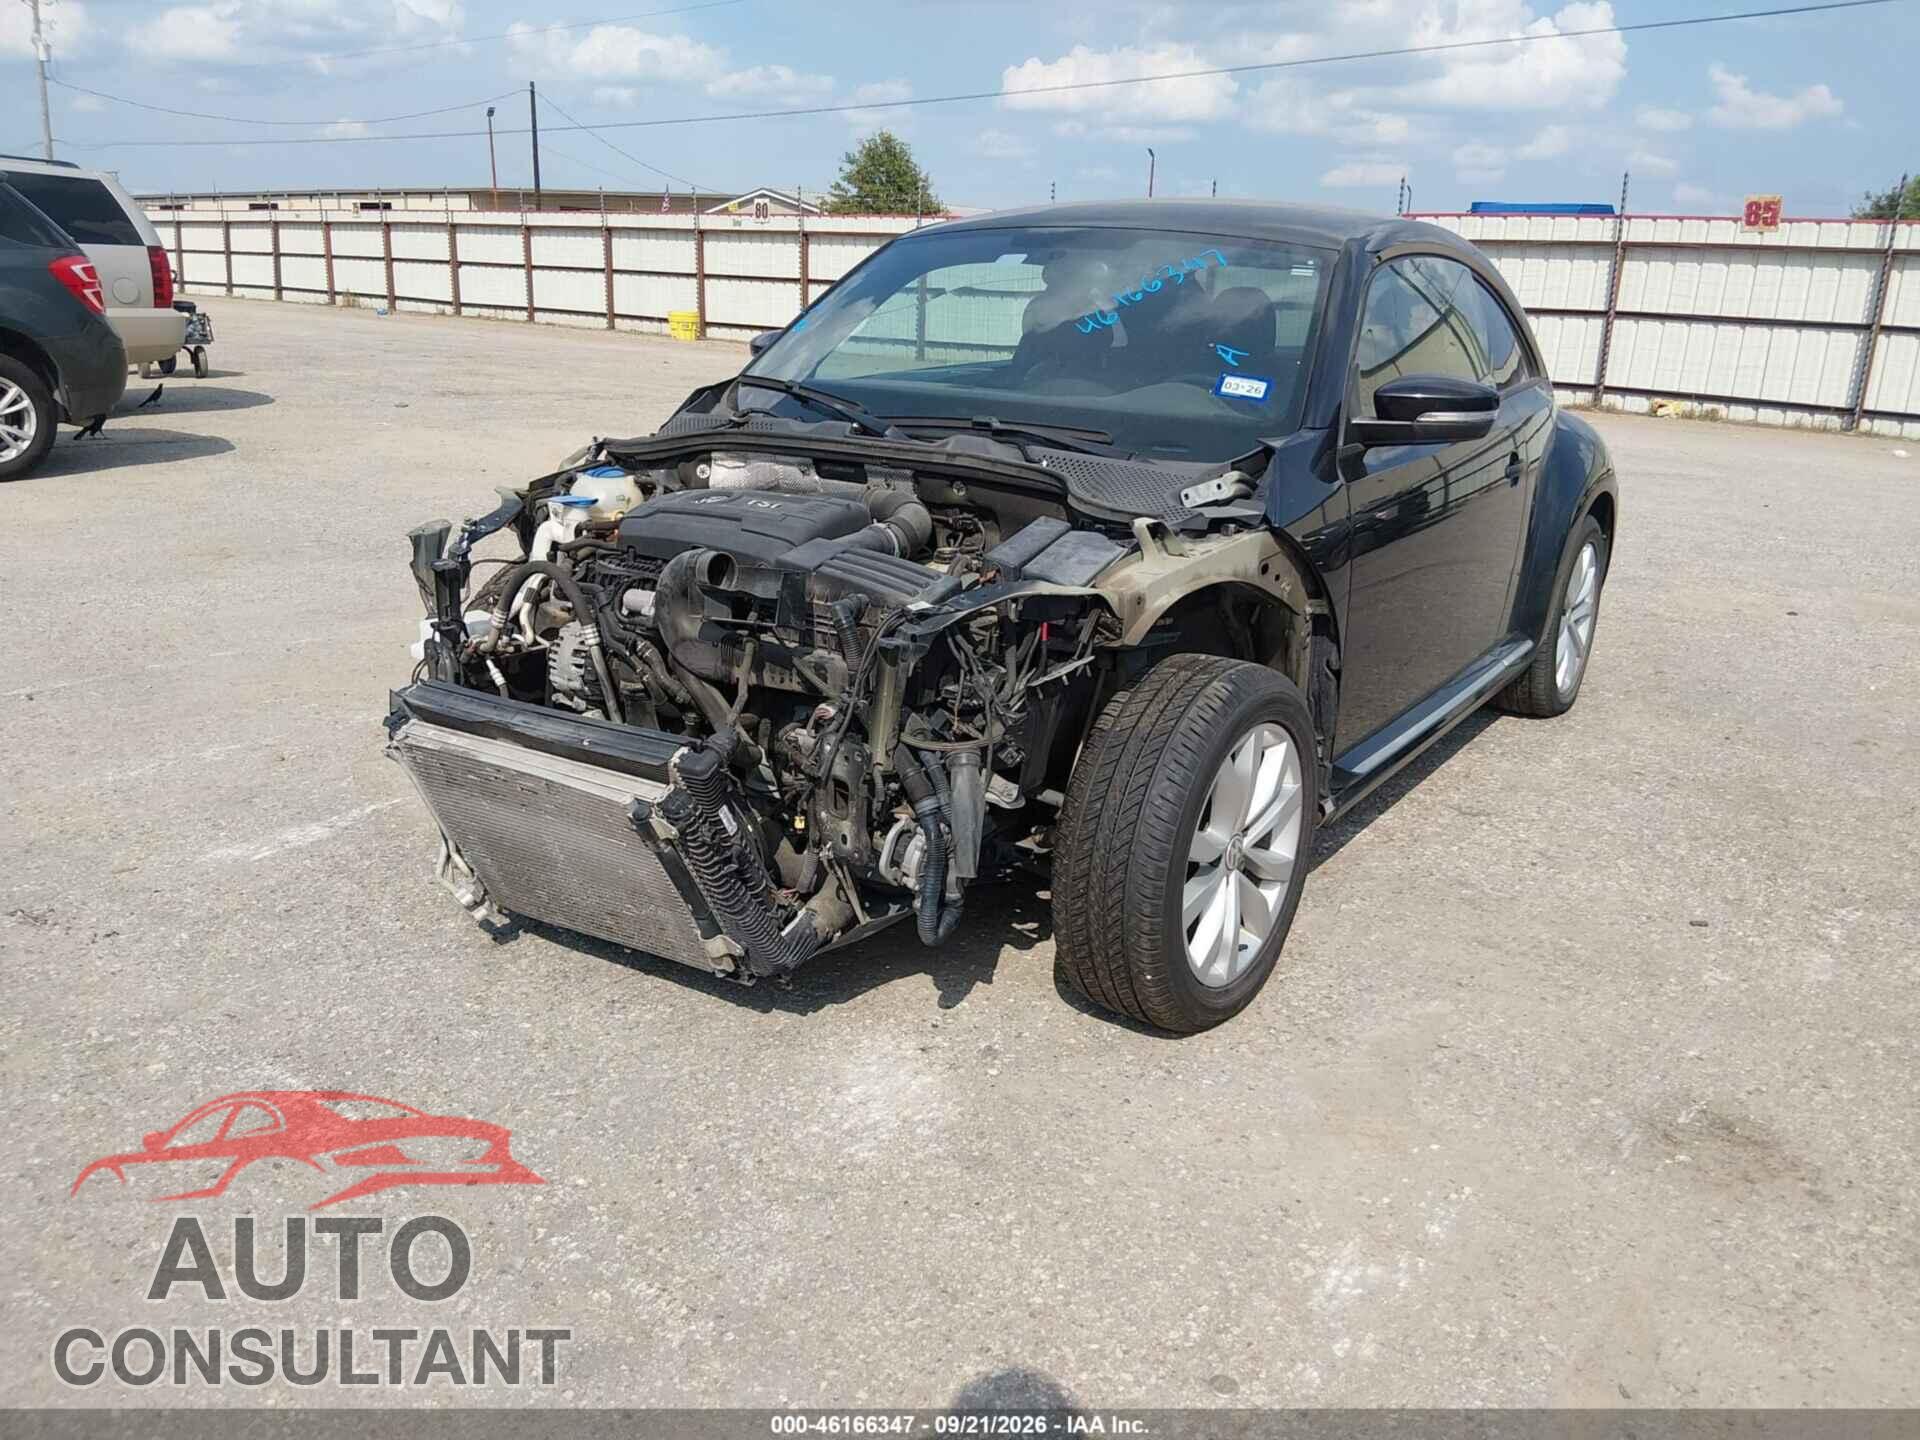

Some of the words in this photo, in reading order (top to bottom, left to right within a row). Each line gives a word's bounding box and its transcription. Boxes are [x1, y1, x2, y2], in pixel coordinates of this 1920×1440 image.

[755, 203, 768, 218] 80
[1745, 201, 1778, 226] 85
[1075, 249, 1227, 334] 46166347
[1215, 344, 1250, 367] A
